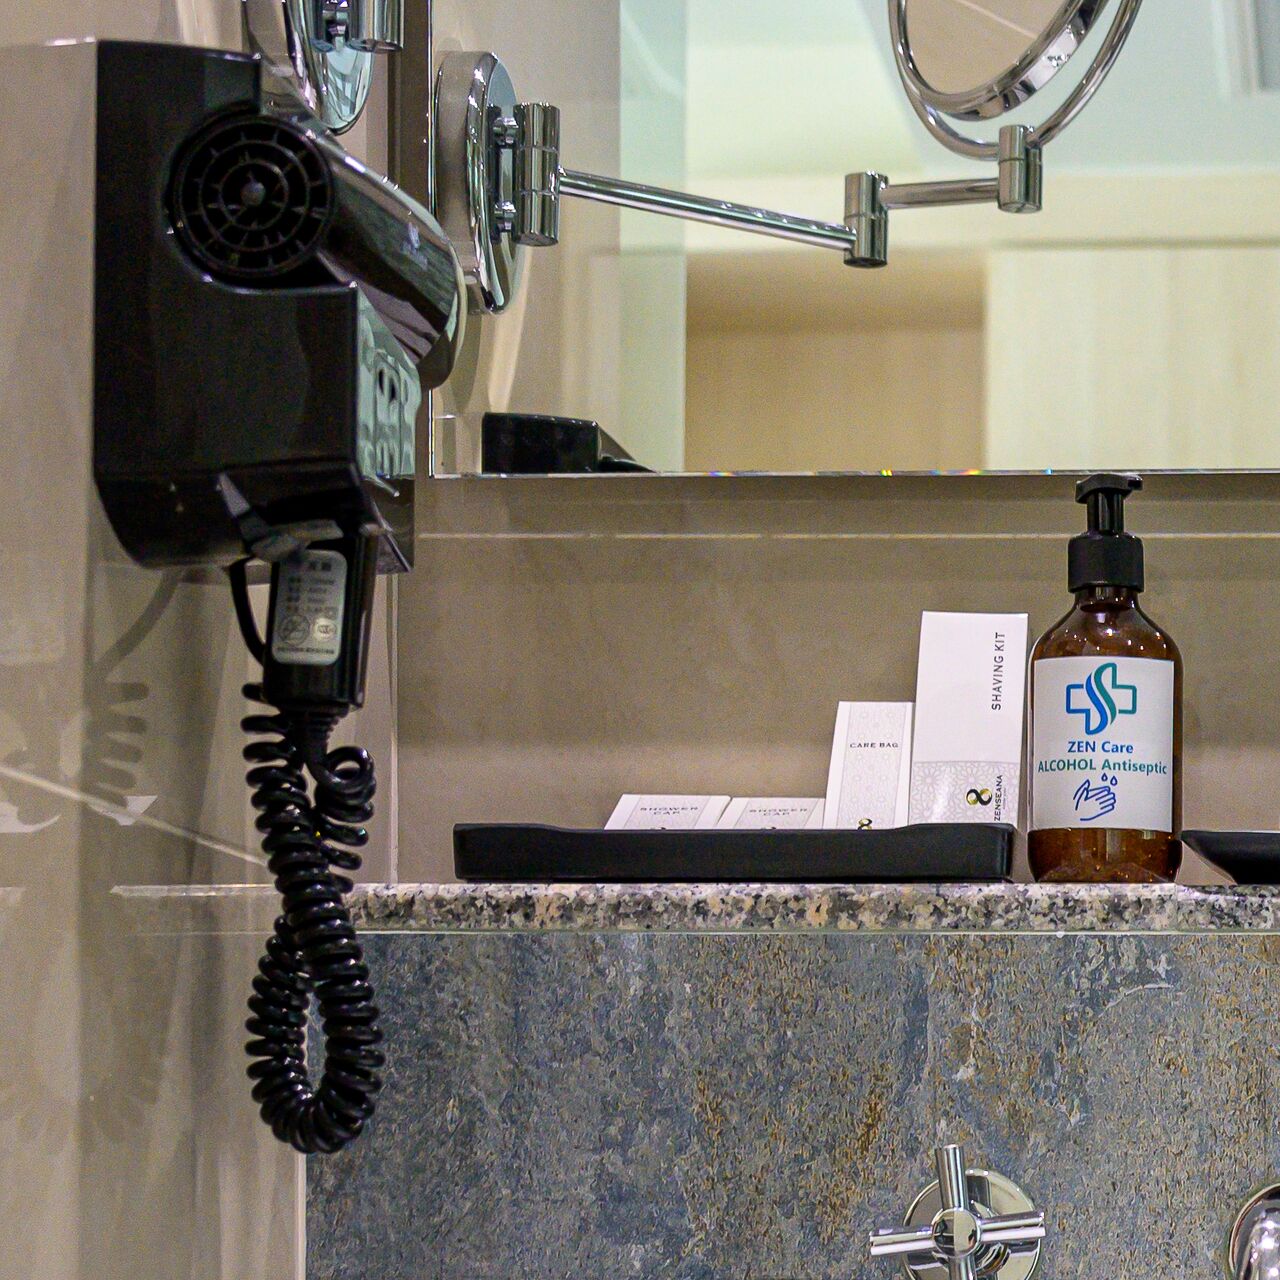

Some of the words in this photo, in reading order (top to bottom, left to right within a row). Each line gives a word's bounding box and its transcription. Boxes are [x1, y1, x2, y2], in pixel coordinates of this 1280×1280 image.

[994, 632, 1006, 652] KIT
[991, 654, 1005, 711] SHAVING
[1067, 740, 1097, 754] ZEN
[1101, 740, 1134, 754] Care
[1037, 758, 1097, 773] ALCOHOL
[1101, 758, 1168, 777] Antiseptic
[993, 774, 1004, 822] ZENSEANA
